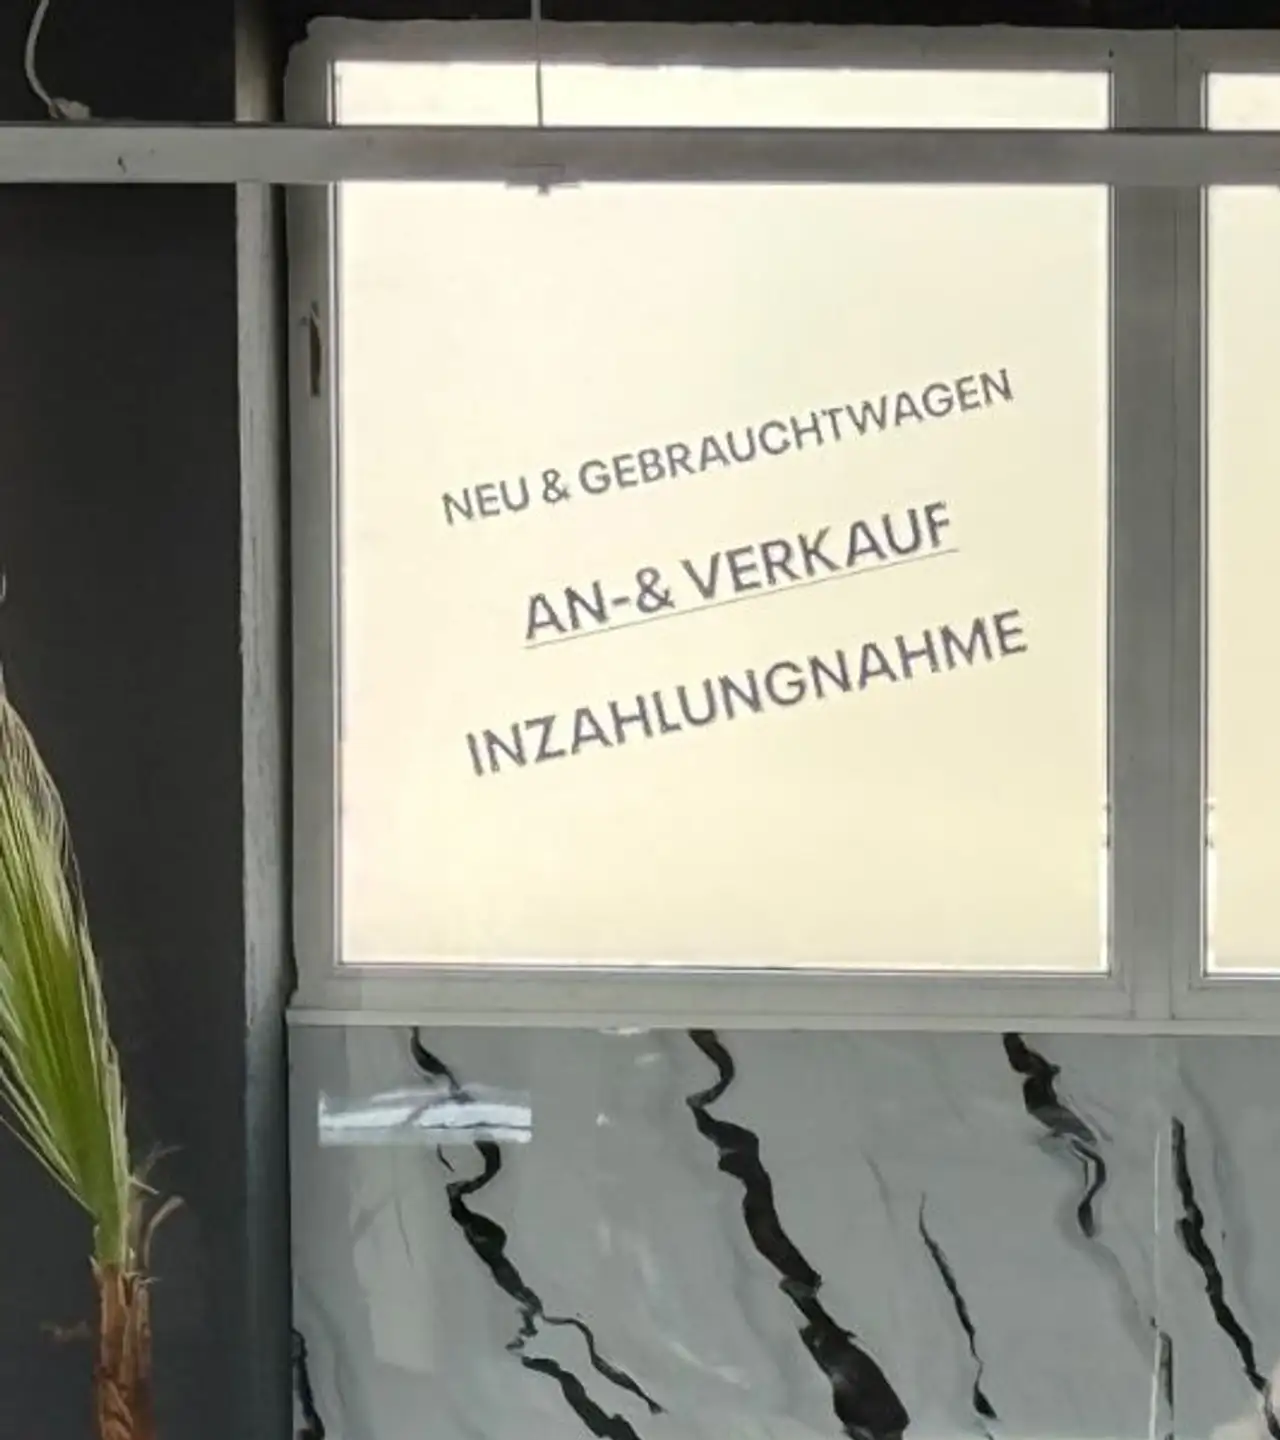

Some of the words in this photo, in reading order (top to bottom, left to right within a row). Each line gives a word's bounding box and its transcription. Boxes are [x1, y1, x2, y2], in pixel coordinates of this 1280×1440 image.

[443, 477, 529, 524] NEU
[543, 469, 570, 503] &
[579, 369, 1013, 494] GEBRAUCHTWAGEN
[682, 502, 949, 598] VERKAUF
[467, 610, 1027, 776] INZAHLUNGNAHME
